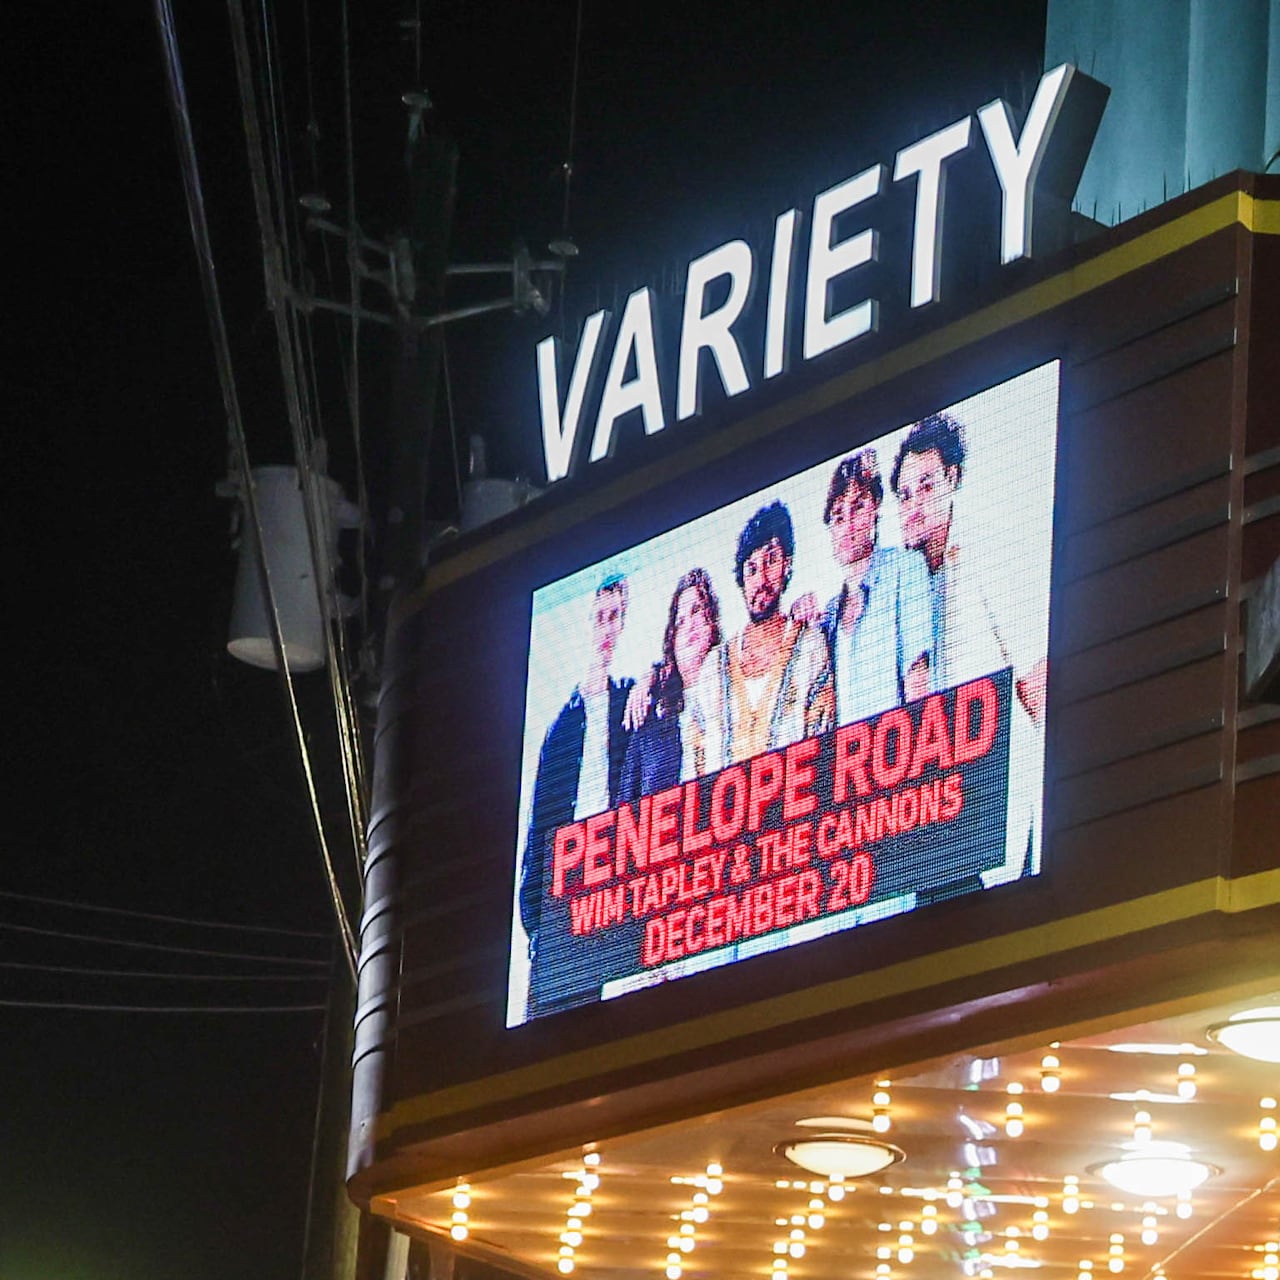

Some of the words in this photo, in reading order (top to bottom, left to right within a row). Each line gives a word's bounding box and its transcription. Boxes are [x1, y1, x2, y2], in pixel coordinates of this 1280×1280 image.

[535, 61, 1078, 483] VARIETY
[551, 738, 818, 897] PENELOPE
[832, 677, 1000, 805] ROAD
[628, 850, 728, 918] TAPLEY
[729, 843, 751, 886] &
[756, 820, 814, 877] THE
[815, 772, 964, 859] CANNONS
[641, 866, 823, 967] DECEMBER
[826, 850, 874, 912] 20
